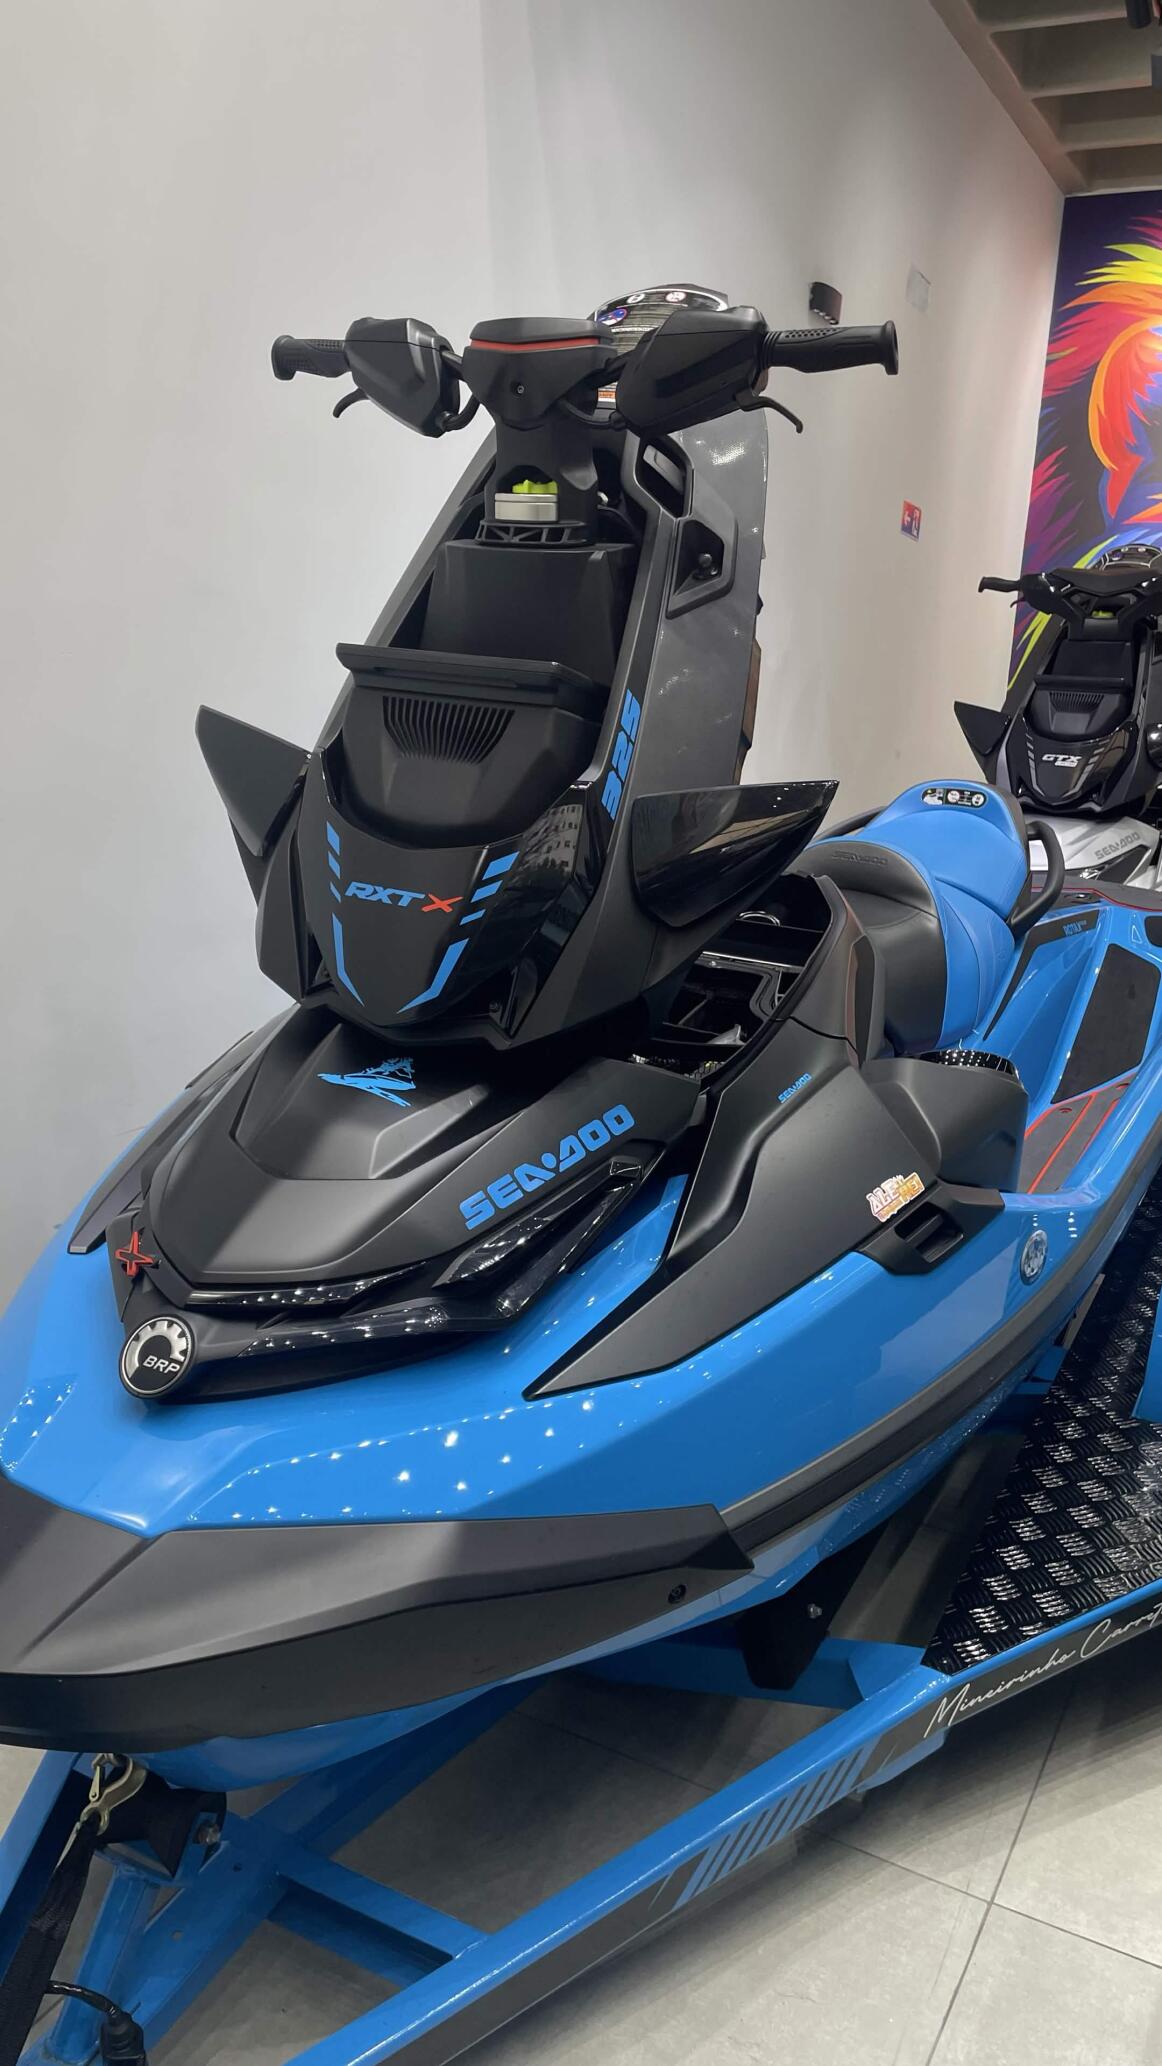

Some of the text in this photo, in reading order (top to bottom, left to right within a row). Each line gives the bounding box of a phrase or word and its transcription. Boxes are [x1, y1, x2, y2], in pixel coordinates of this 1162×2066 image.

[601, 688, 641, 821] 325
[1042, 753, 1082, 763] GTX
[344, 881, 426, 907] RXT
[142, 1355, 180, 1374] BRP
[923, 1649, 1076, 1738] Mineirinho
